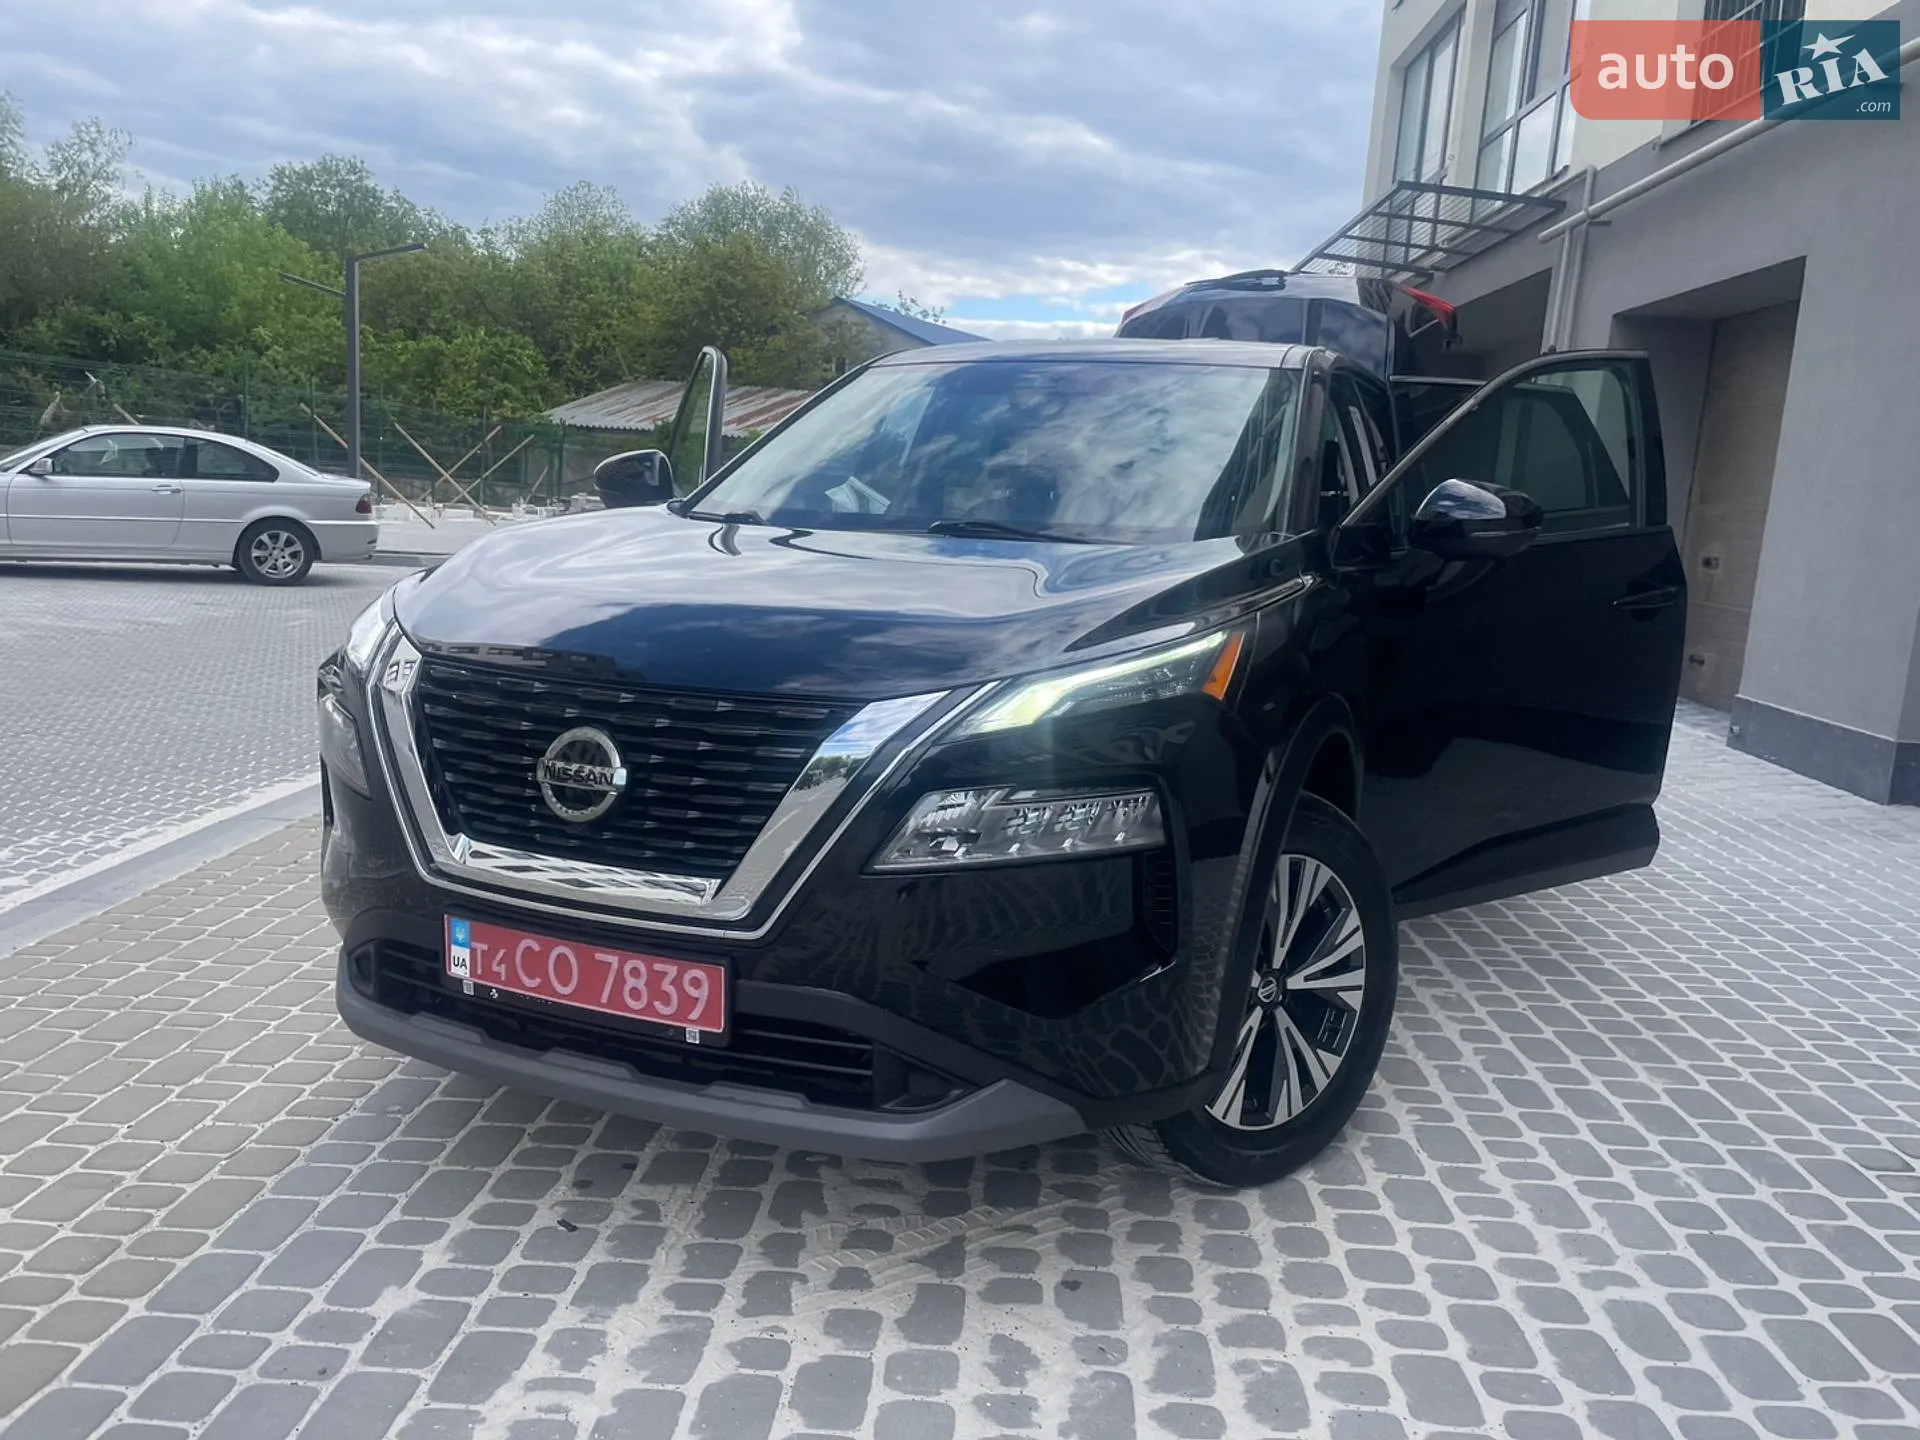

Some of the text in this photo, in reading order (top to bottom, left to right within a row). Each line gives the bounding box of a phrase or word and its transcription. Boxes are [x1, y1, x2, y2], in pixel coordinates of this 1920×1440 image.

[543, 763, 615, 787] NISSAN
[453, 955, 468, 970] UA
[594, 953, 710, 1021] 7839
